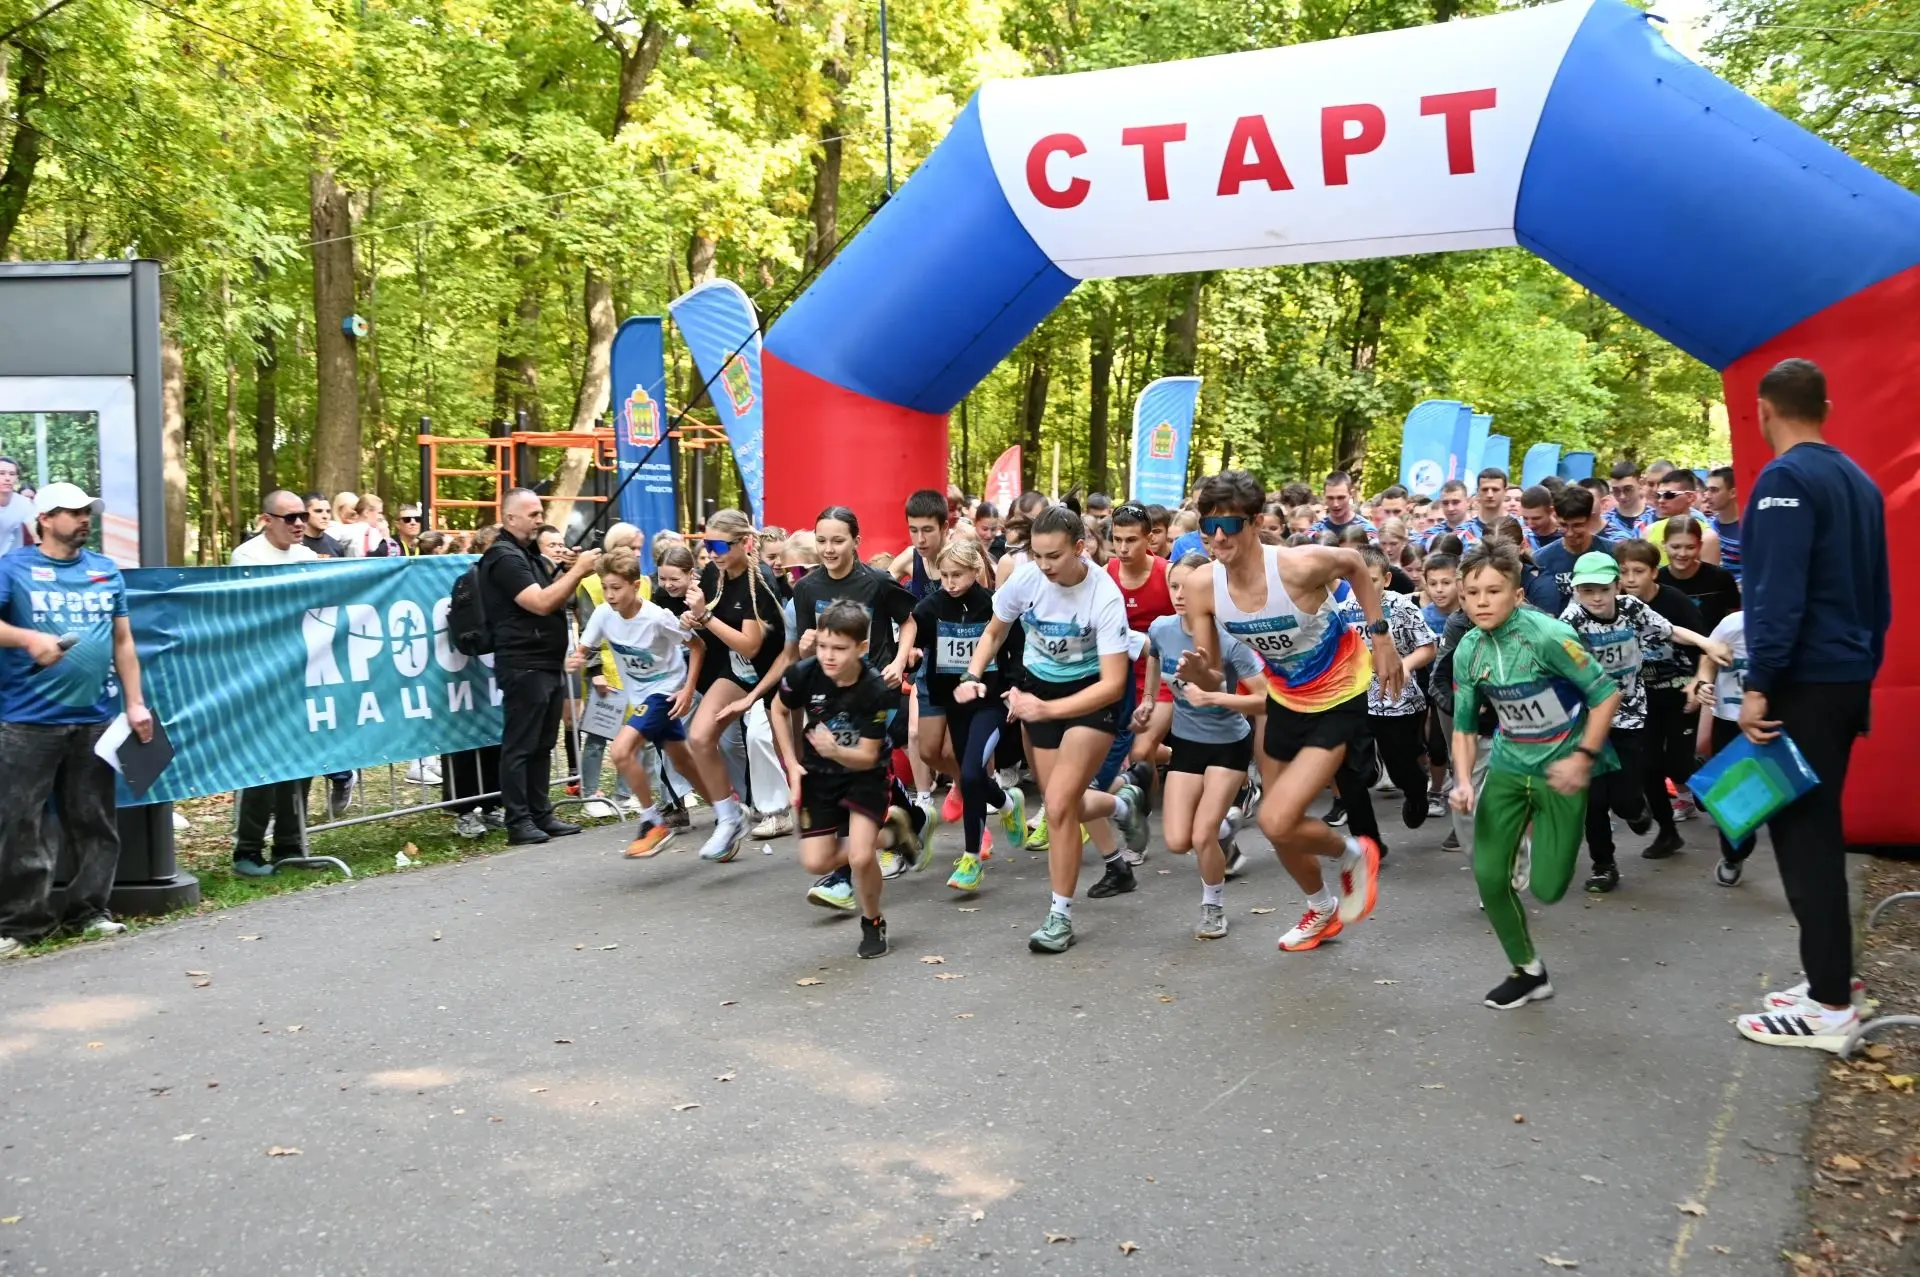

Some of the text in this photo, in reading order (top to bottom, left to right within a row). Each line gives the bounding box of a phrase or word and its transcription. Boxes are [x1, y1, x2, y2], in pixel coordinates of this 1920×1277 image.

[1026, 88, 1497, 209] СТАРТ
[30, 591, 114, 612] КРОСС
[302, 597, 495, 687] КРОС
[947, 640, 979, 657] 151
[1499, 700, 1546, 721] 1311
